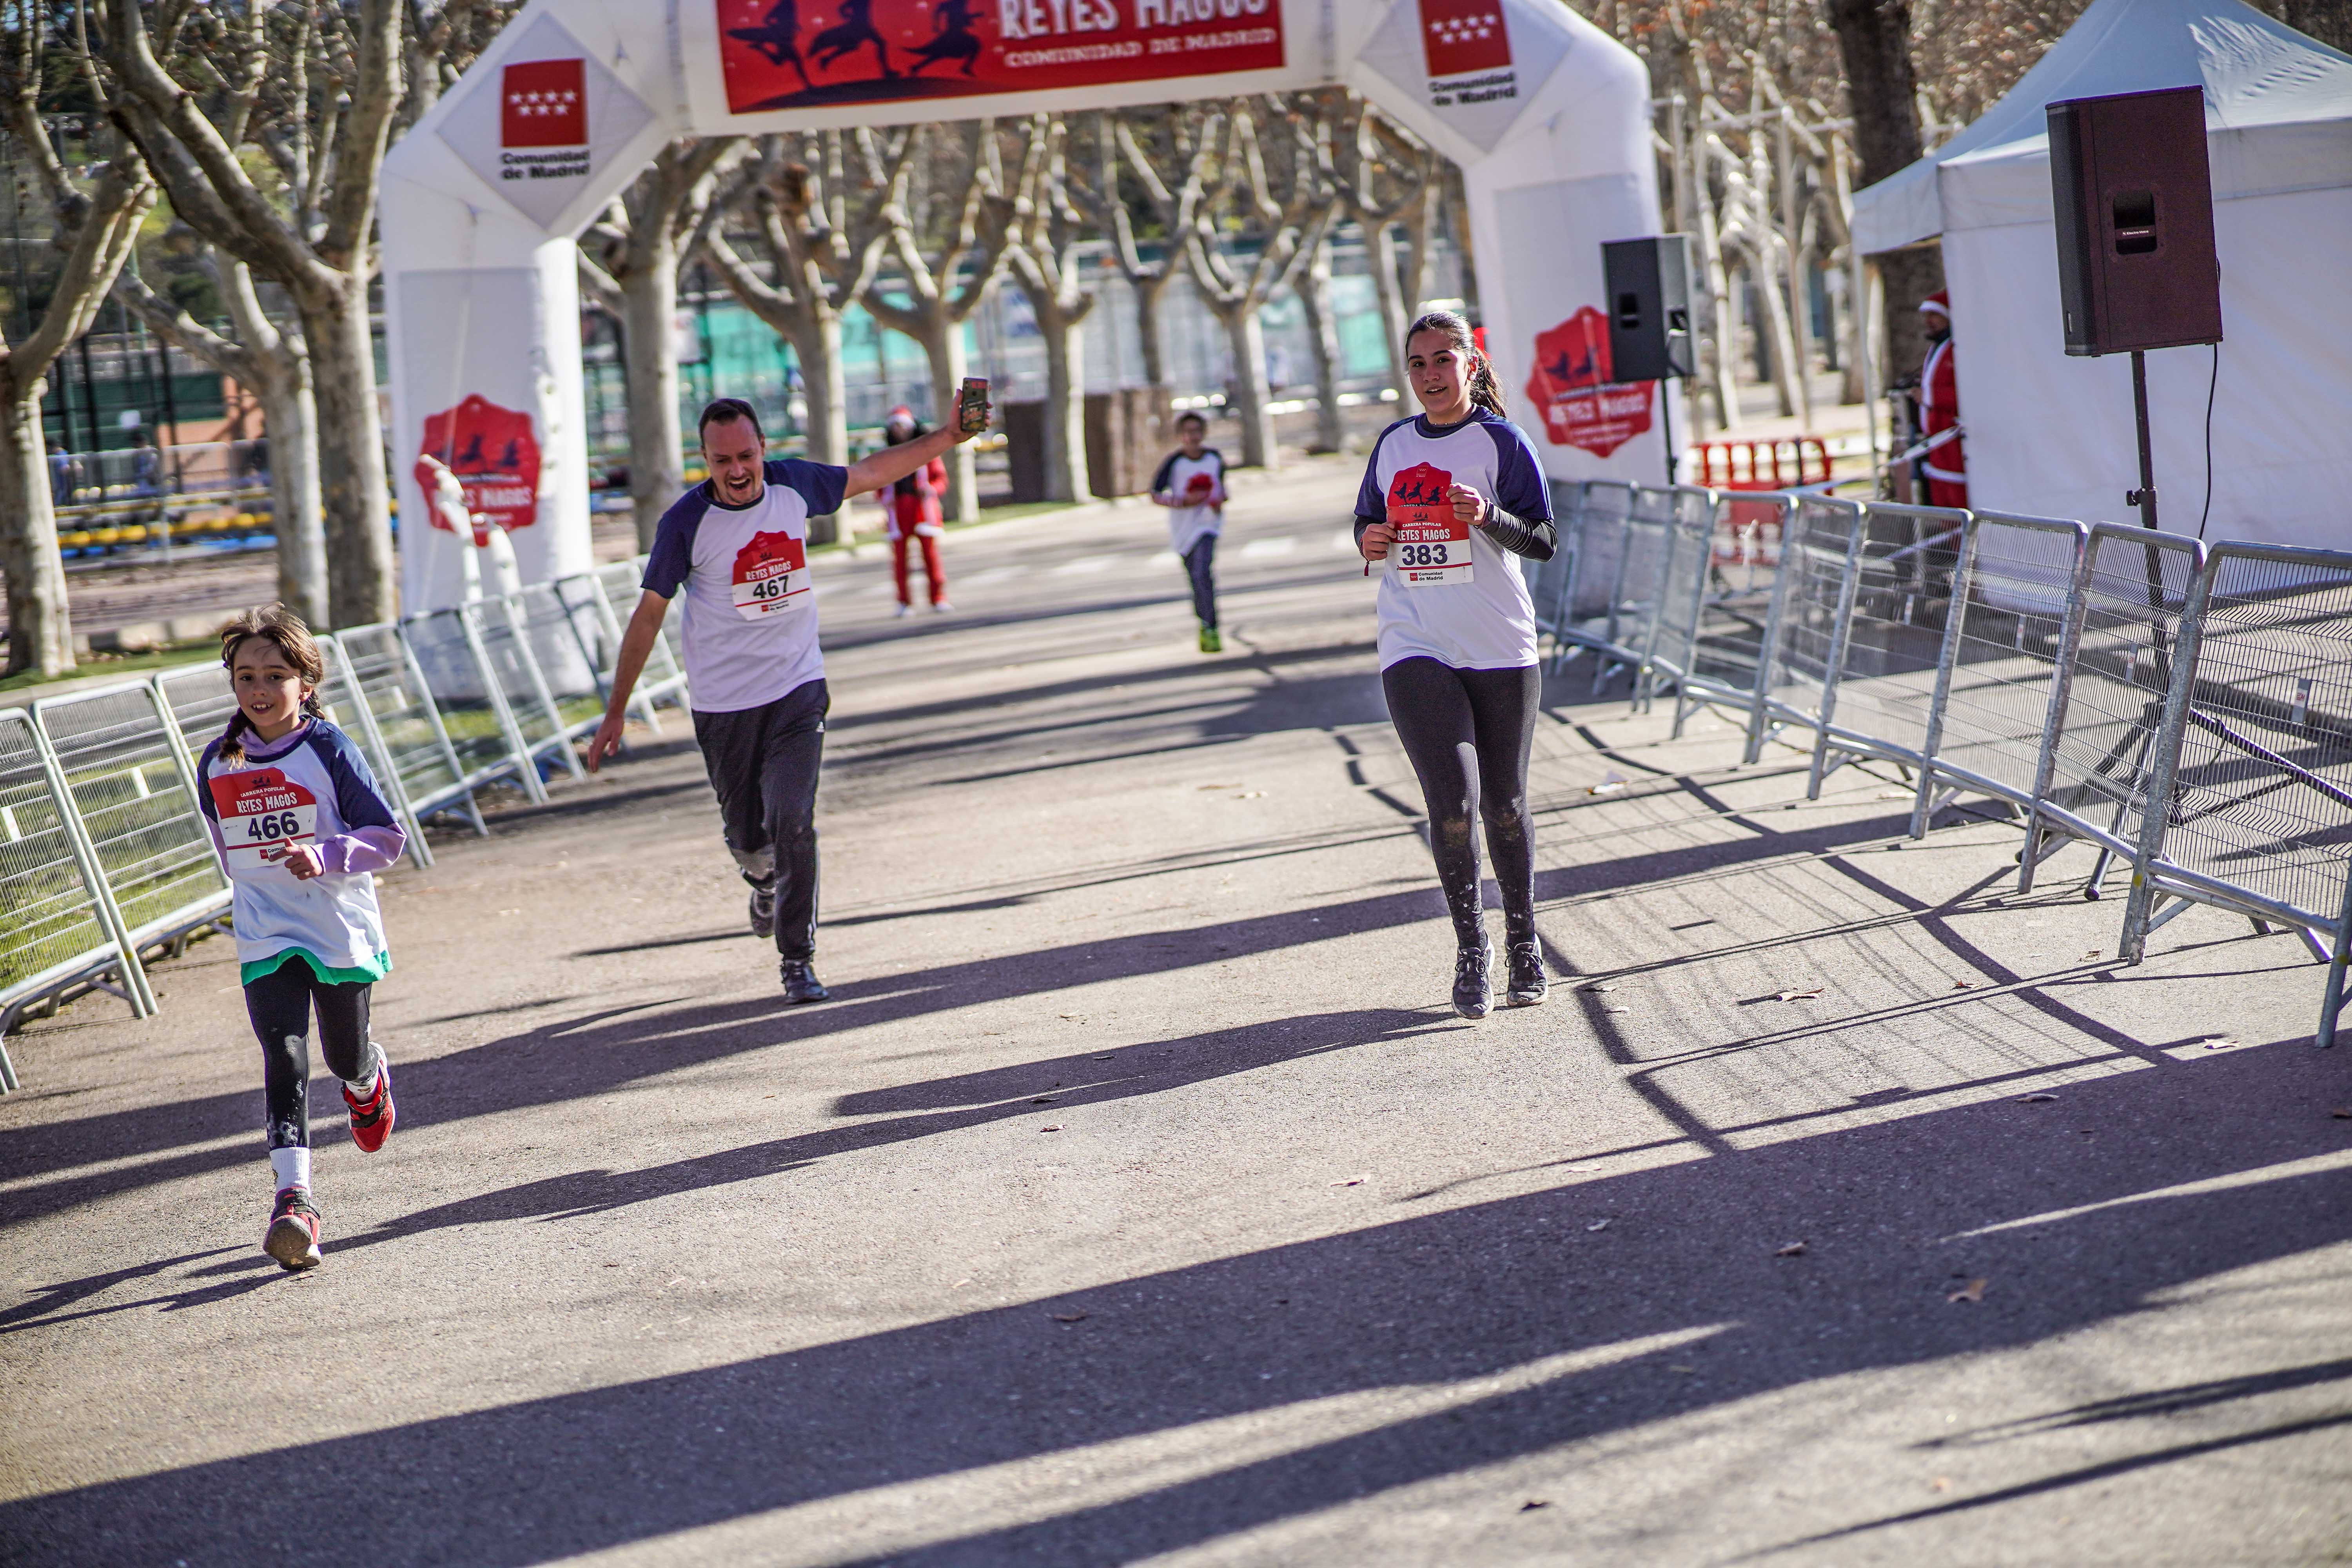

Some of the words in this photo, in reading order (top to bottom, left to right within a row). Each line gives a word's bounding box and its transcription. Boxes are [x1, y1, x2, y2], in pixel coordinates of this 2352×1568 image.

[1397, 530, 1419, 541] REYES
[1422, 528, 1450, 540] MAGOS
[1402, 544, 1448, 565] 383
[746, 568, 768, 580] REYES
[769, 561, 791, 576] MAGOS
[753, 575, 789, 599] 467
[236, 799, 263, 813] REYES
[265, 792, 297, 810] MAGOS
[248, 811, 299, 840] 466
